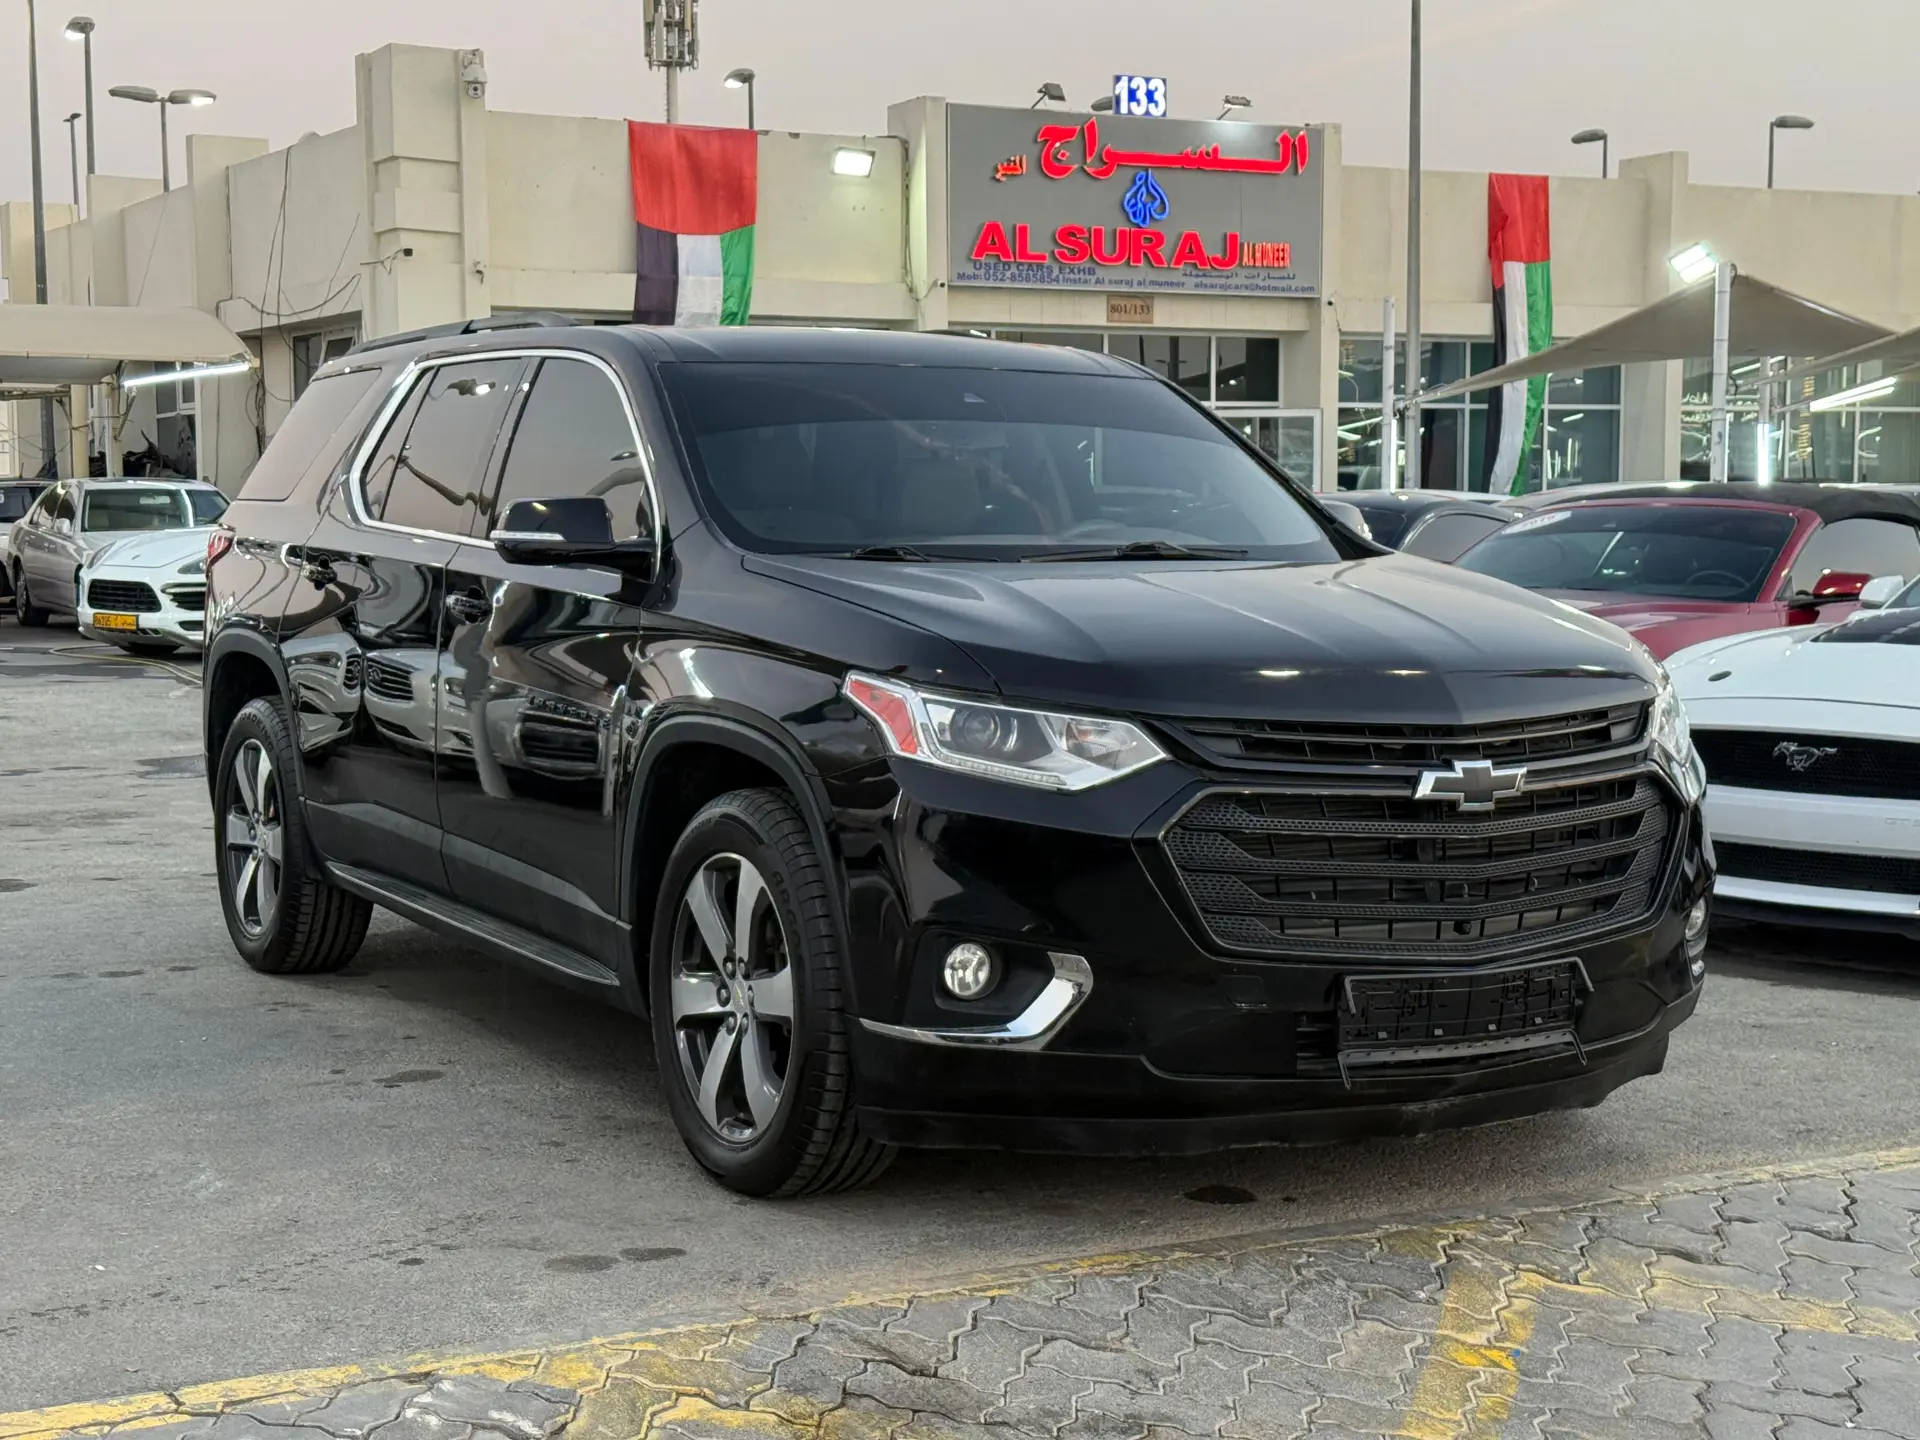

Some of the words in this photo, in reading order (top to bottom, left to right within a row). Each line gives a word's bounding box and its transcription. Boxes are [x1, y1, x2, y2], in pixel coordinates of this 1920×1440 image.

[1114, 75, 1166, 117] 133
[1036, 116, 1310, 179] السراج
[971, 220, 1048, 263] AL
[1054, 223, 1240, 269] SURAJ
[973, 261, 1012, 272] USED
[1016, 263, 1054, 274] CARS
[1058, 266, 1097, 276] EXHB
[1109, 303, 1151, 316] 801/133
